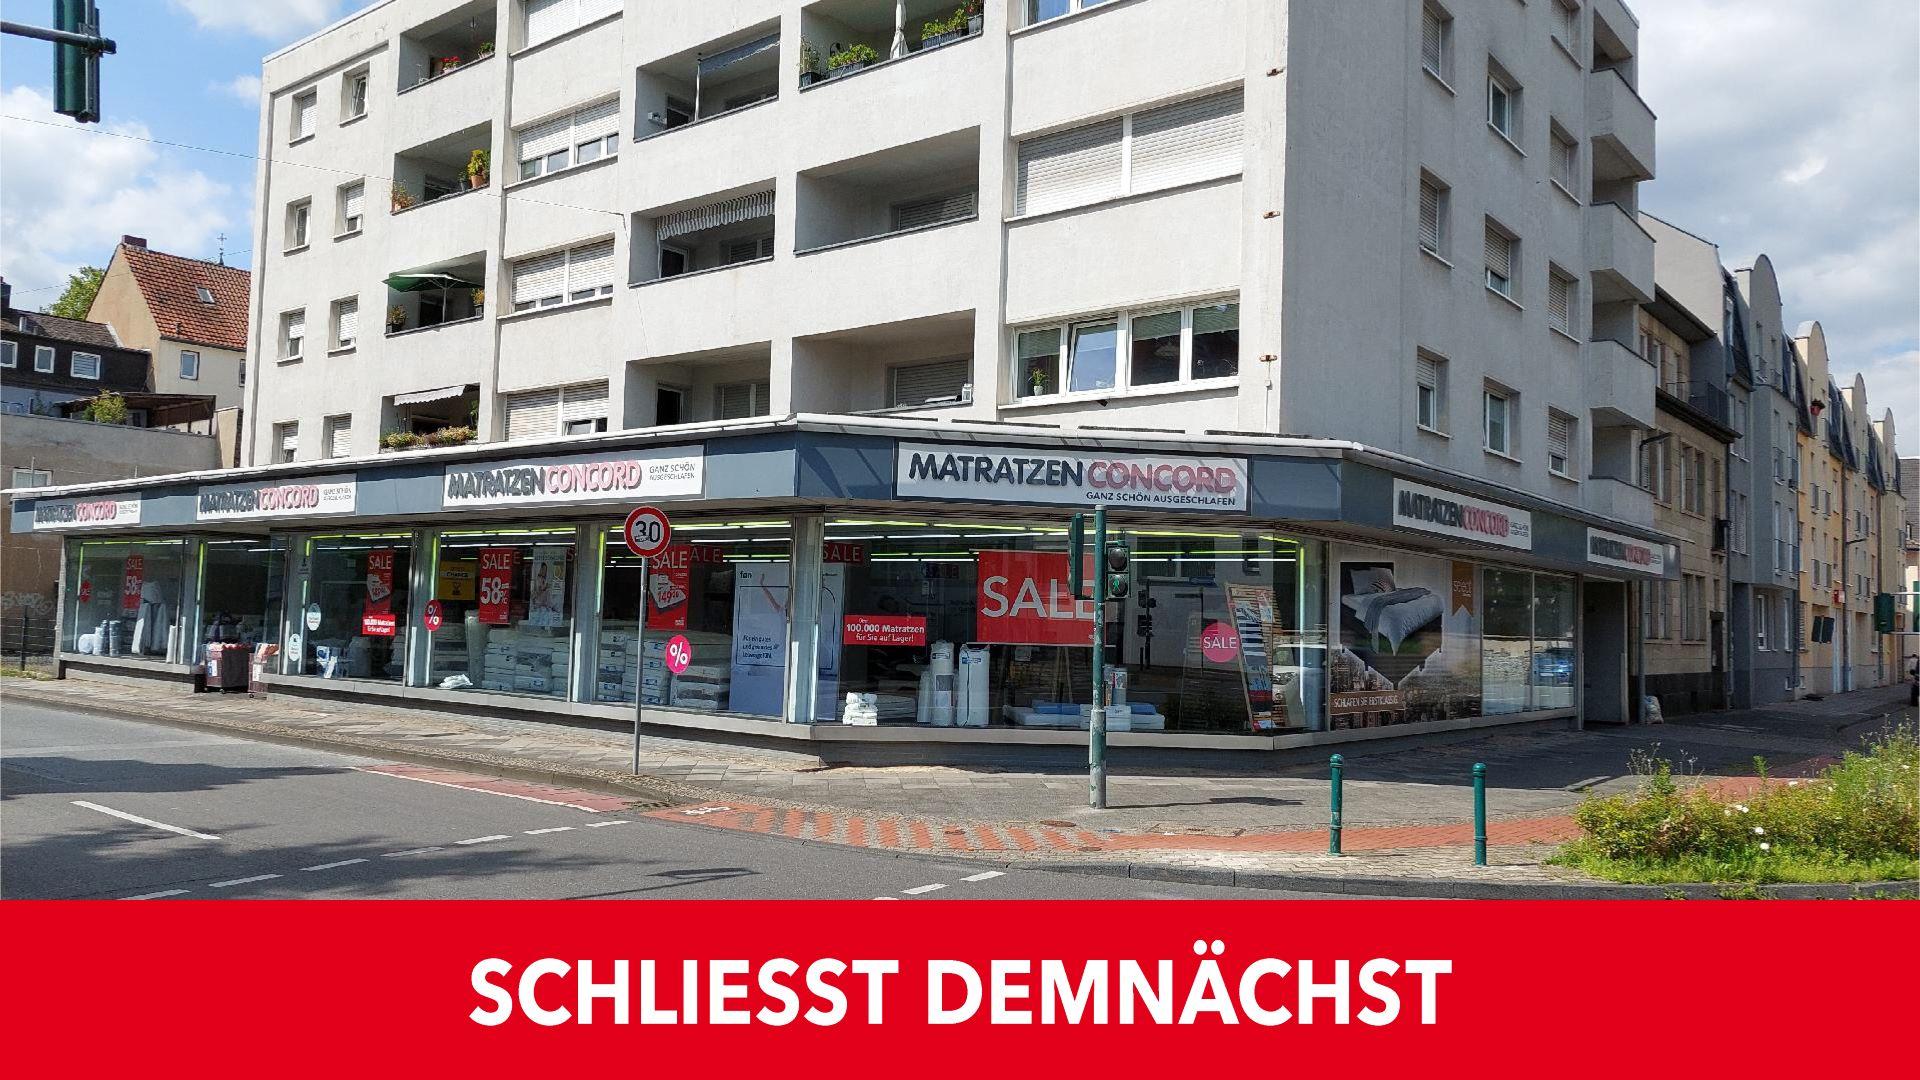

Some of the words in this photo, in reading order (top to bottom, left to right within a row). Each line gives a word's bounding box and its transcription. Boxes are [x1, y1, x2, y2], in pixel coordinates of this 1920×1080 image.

[544, 459, 642, 495] CONCORD
[1087, 458, 1237, 494] CONCORD
[1086, 491, 1114, 501] GANZ
[1116, 491, 1151, 503] SCHÖN
[1153, 494, 1236, 506] AUSGESCHLAFEN
[635, 520, 661, 543] 30
[368, 555, 392, 570] SALE
[482, 553, 510, 570] SALE
[651, 550, 688, 569] SALE
[481, 577, 502, 605] 58
[980, 575, 1096, 620] SALE
[846, 623, 880, 633] 100.000
[882, 624, 925, 634] Matratzen
[1203, 636, 1238, 650] SALE
